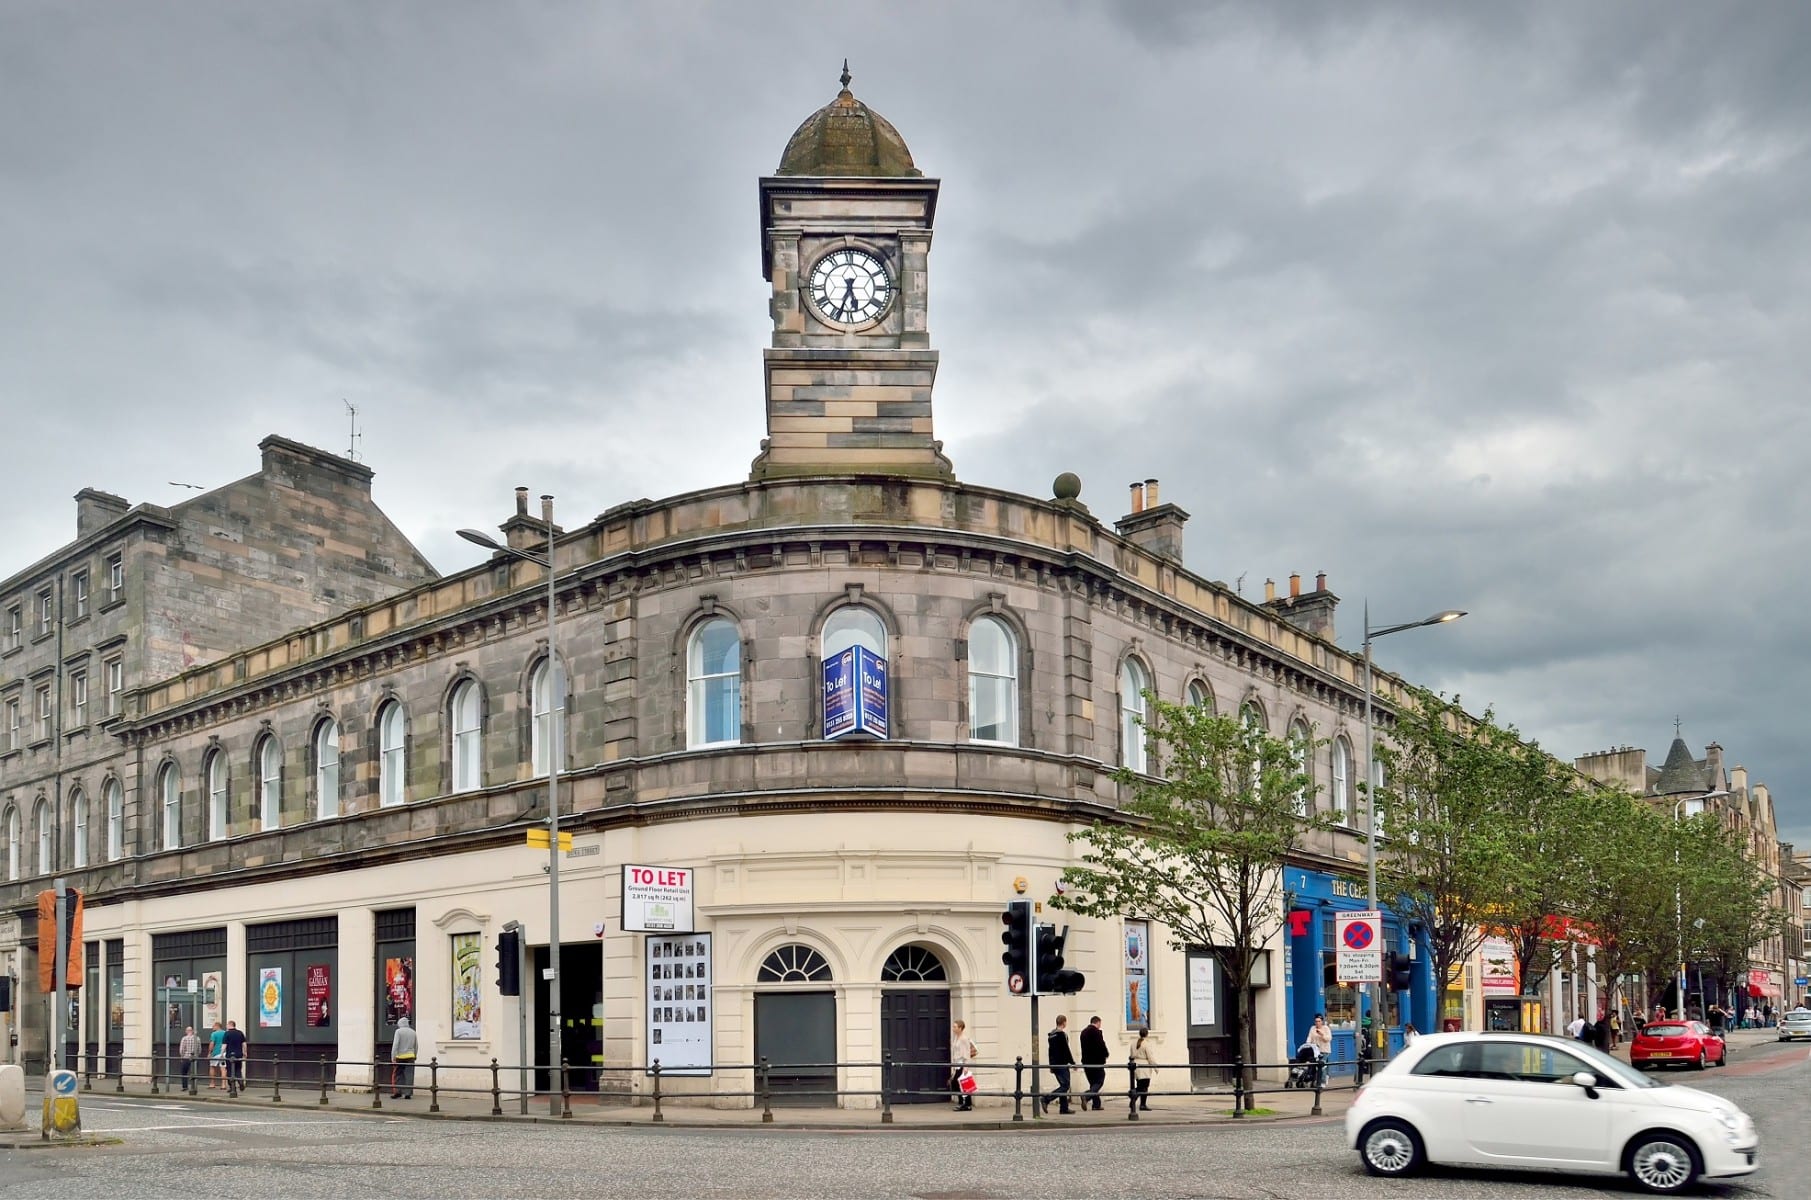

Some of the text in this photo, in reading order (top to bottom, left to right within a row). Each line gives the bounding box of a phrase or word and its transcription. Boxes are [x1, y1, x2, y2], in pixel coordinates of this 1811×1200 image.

[826, 675, 847, 693] To Let
[863, 672, 881, 690] To Let
[632, 869, 686, 886] TO LET
[1301, 875, 1306, 889] 7
[1332, 879, 1348, 897] THE
